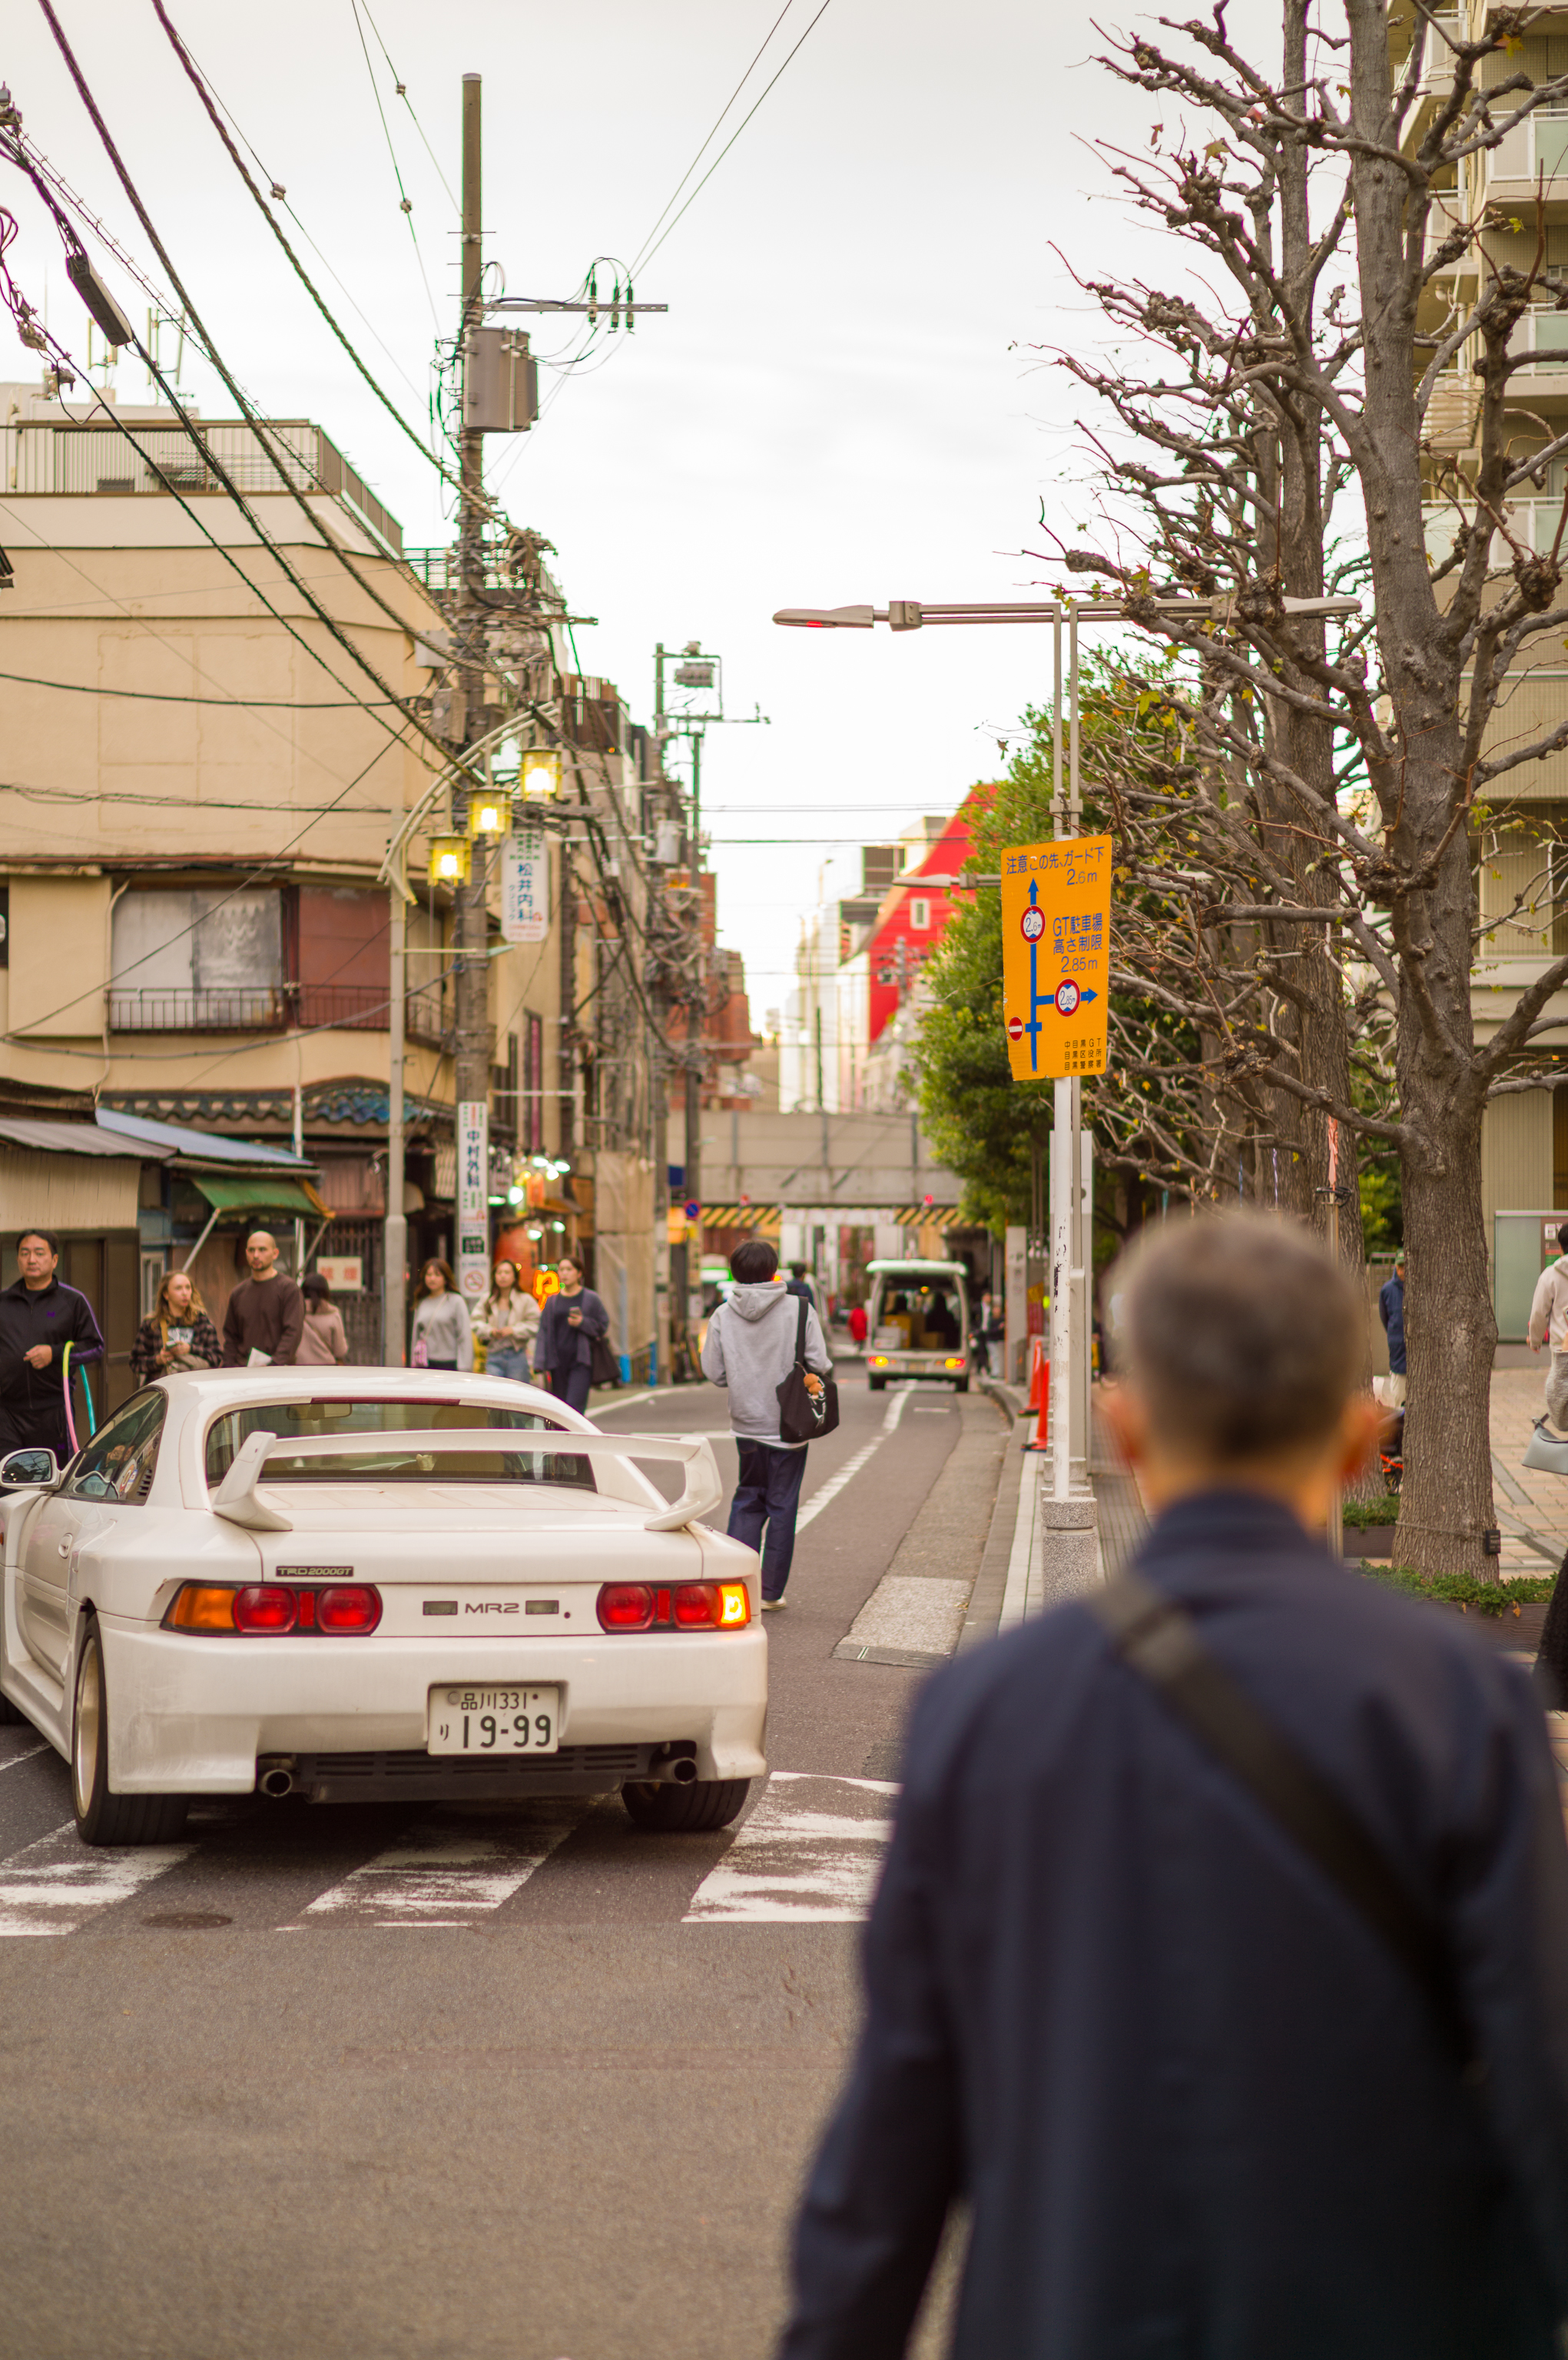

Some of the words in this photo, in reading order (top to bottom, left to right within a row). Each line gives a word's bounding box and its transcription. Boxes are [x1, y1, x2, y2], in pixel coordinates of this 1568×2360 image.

[1053, 913, 1103, 937] GT駐車場
[1053, 934, 1102, 955] 高さ制限
[1064, 1048, 1102, 1059] 目黒区役所
[1064, 1059, 1102, 1071] 目黒警察署
[464, 1602, 519, 1614] MR2
[439, 1723, 449, 1742] り
[463, 1715, 552, 1748] 19-99
